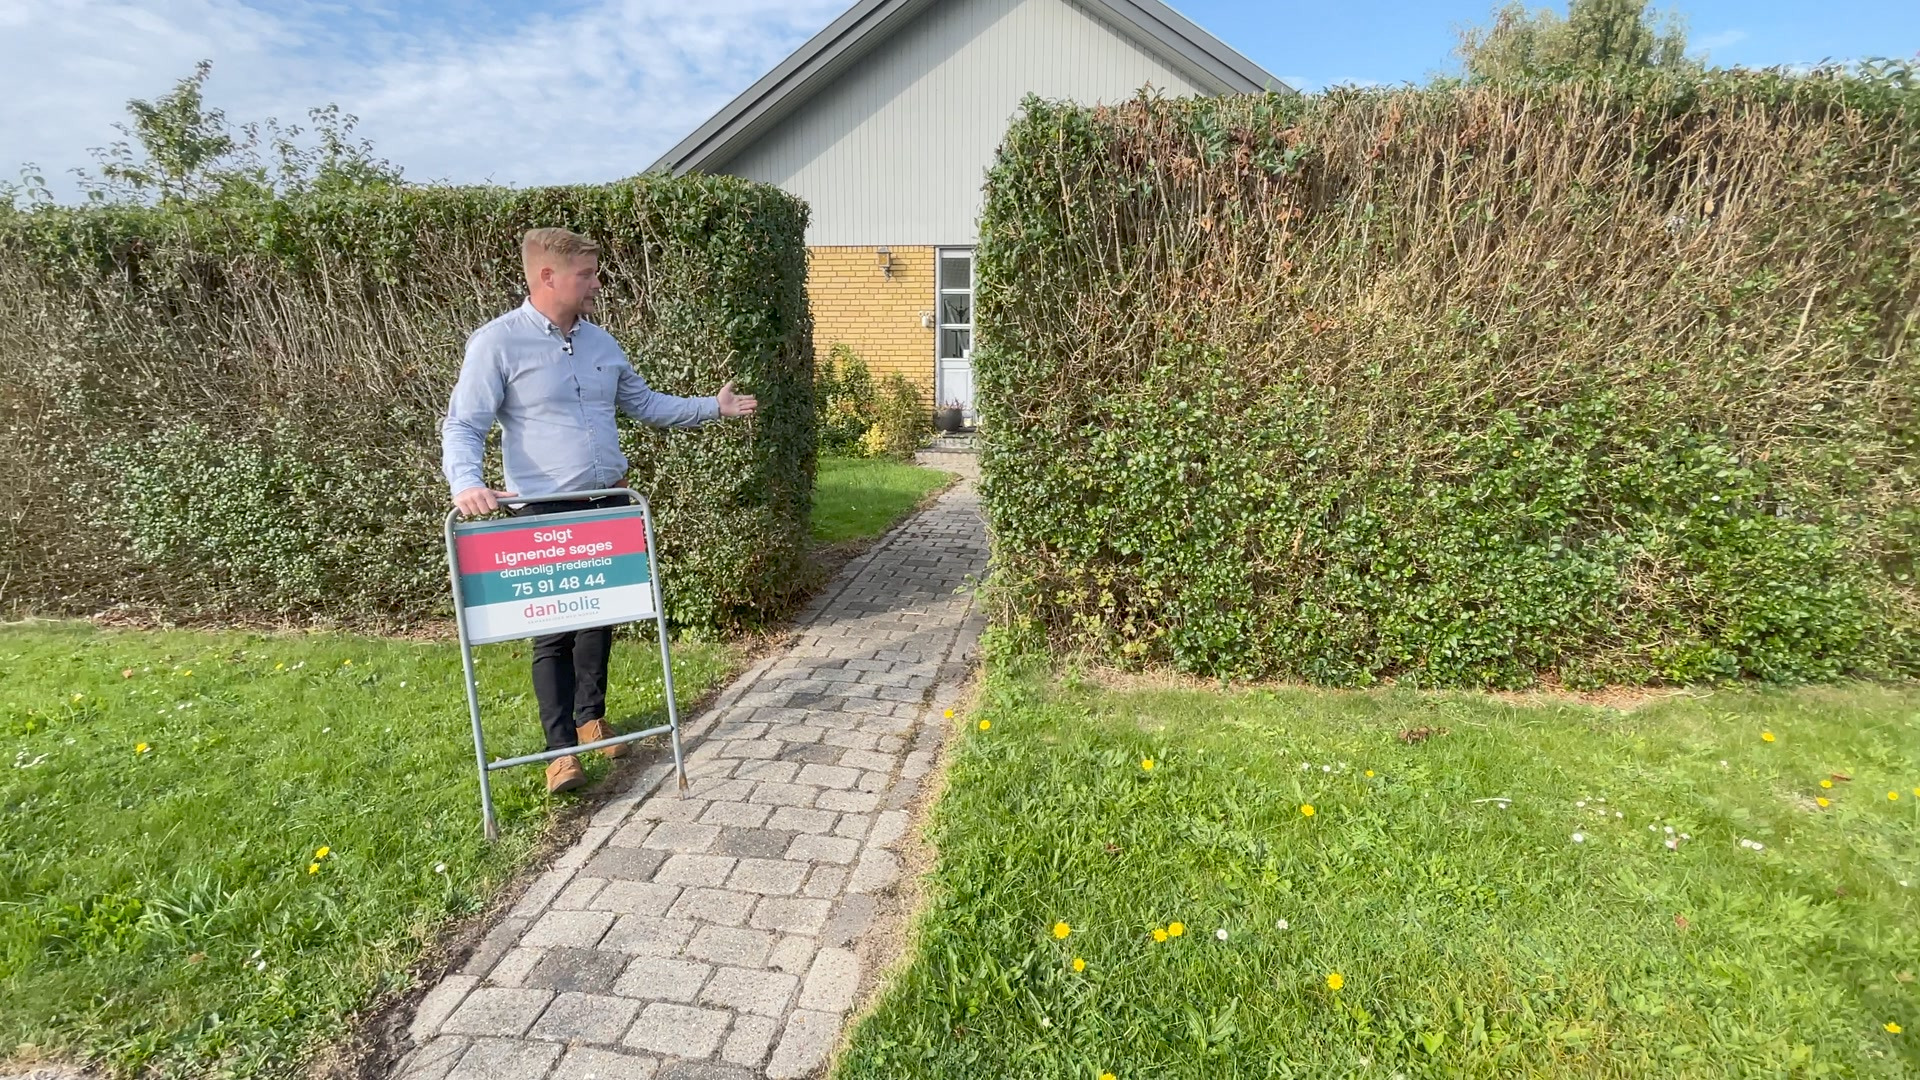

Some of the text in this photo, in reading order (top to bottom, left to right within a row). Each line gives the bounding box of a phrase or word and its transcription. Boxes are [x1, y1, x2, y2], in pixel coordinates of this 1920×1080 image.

[533, 528, 573, 543] Solgt
[495, 541, 613, 565] Lignende søges
[500, 556, 612, 578] danbolig Fredericia
[512, 573, 606, 596] 75 91 48 44
[524, 596, 600, 618] danbolig
